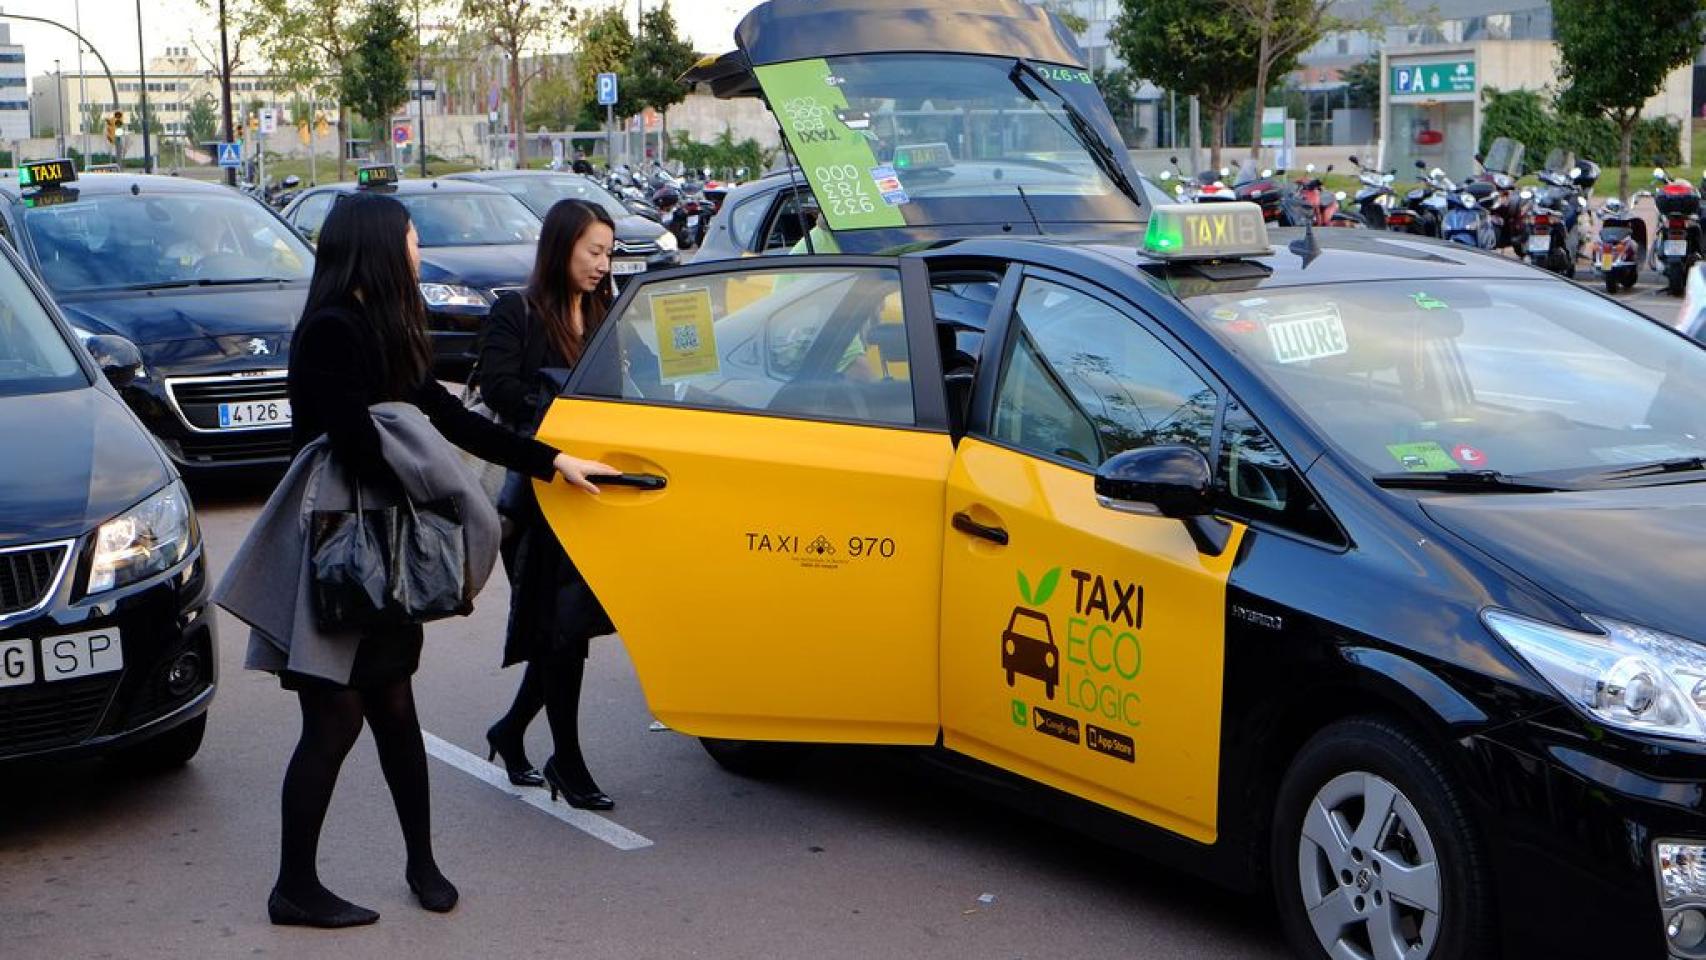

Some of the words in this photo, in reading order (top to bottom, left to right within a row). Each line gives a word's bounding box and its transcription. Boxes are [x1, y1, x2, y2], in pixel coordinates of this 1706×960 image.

[602, 78, 612, 100] P
[1399, 71, 1409, 90] P
[1412, 66, 1425, 91] A
[797, 128, 840, 144] TAXI
[31, 164, 63, 181] TAXI
[815, 165, 859, 182] 000
[823, 180, 869, 199] 783
[833, 197, 875, 216] 932
[1186, 214, 1233, 246] TAXI
[1272, 320, 1344, 358] LLIURE
[233, 402, 278, 422] 4126
[745, 532, 799, 553] TAXI
[848, 536, 896, 558] 970
[1070, 569, 1144, 630] TAXI
[4, 646, 25, 678] G
[53, 634, 111, 673] SP
[1067, 617, 1142, 681] ECO
[1065, 669, 1142, 727] LÒGIC
